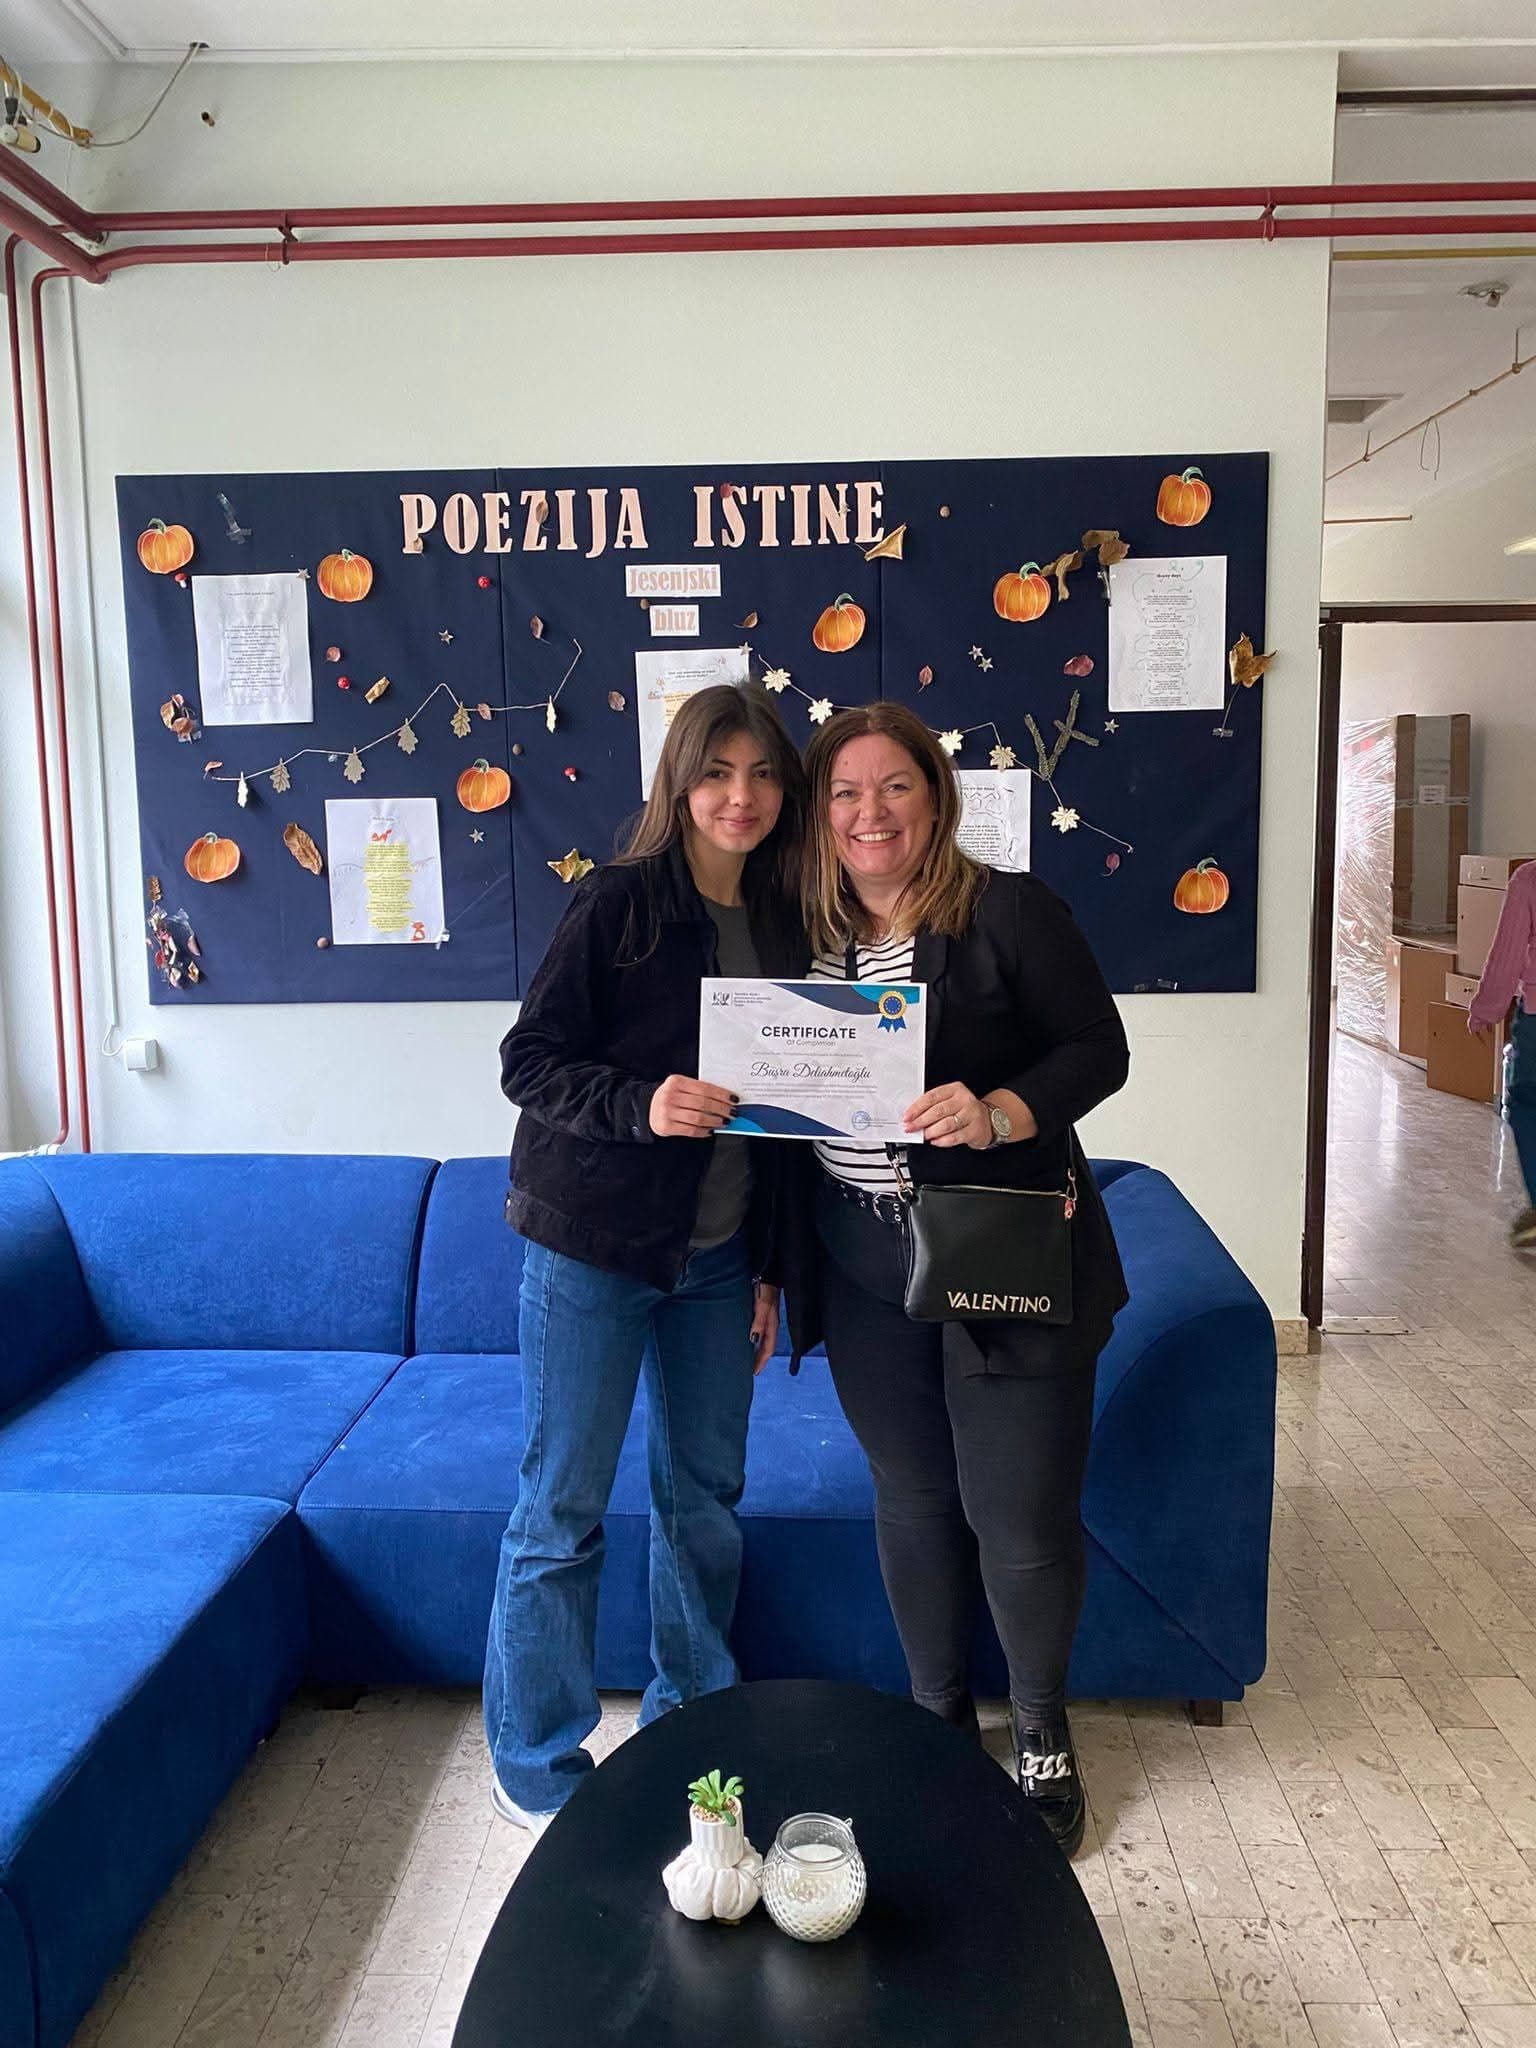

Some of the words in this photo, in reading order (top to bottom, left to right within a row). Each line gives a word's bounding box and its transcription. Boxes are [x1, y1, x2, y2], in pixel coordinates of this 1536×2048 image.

[399, 487, 649, 559] POEZIJA
[692, 480, 886, 550] ISTINE
[654, 607, 696, 631] bluz
[761, 1026, 857, 1039] CERTIFICATE
[796, 1039, 836, 1047] Completion
[750, 1061, 790, 1079] Buşra
[792, 1062, 872, 1083] Deliahmetoğlu
[946, 1291, 1051, 1313] VALENTINO
